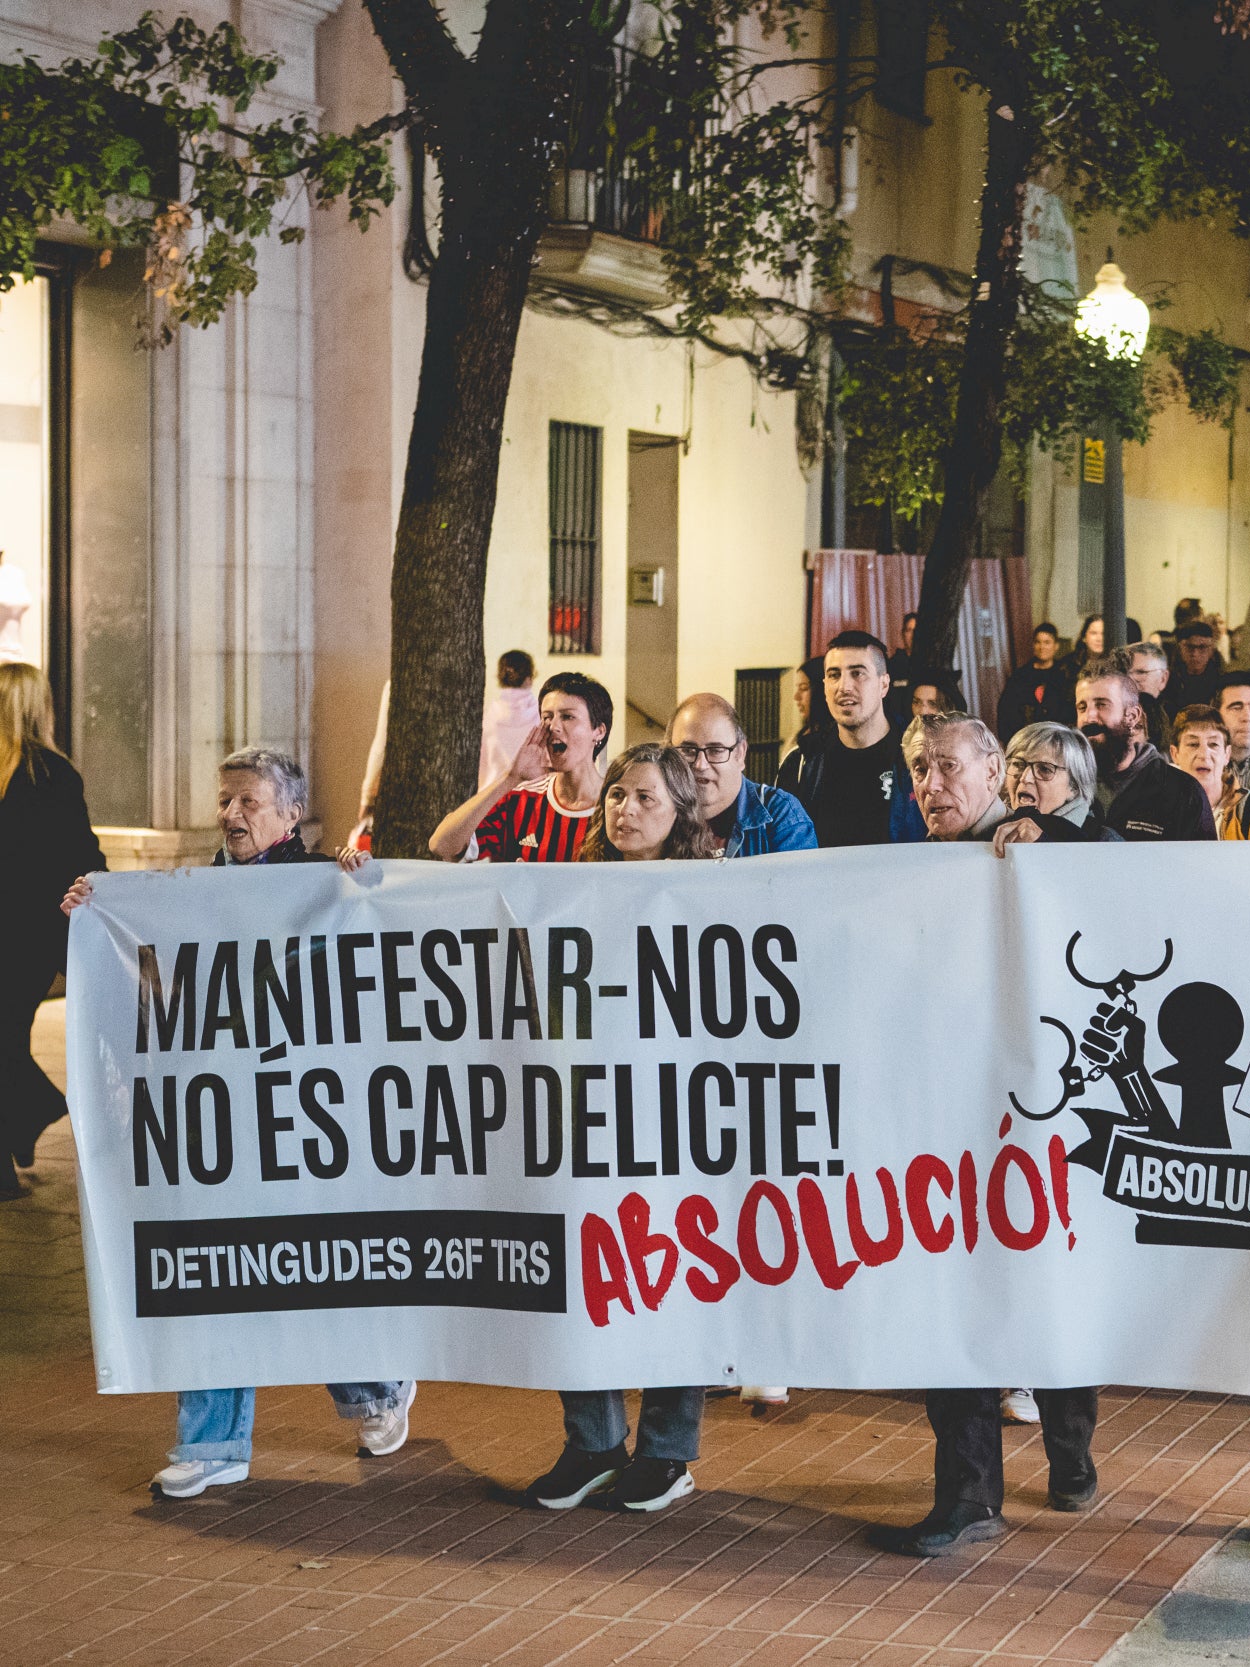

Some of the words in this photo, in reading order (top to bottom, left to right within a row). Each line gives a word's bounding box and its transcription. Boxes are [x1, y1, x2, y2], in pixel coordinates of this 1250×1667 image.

[135, 924, 800, 1053] MANIFESTAR-NOS
[133, 1073, 233, 1186] NO
[256, 1041, 349, 1181] ÉS
[368, 1065, 507, 1176] CAP
[523, 1061, 844, 1177] DELICTE!
[150, 1237, 411, 1290] DETINGUDES
[424, 1237, 483, 1280] 26F
[491, 1239, 550, 1286] TRS
[581, 1112, 1077, 1327] ABSOLUCIÓ!
